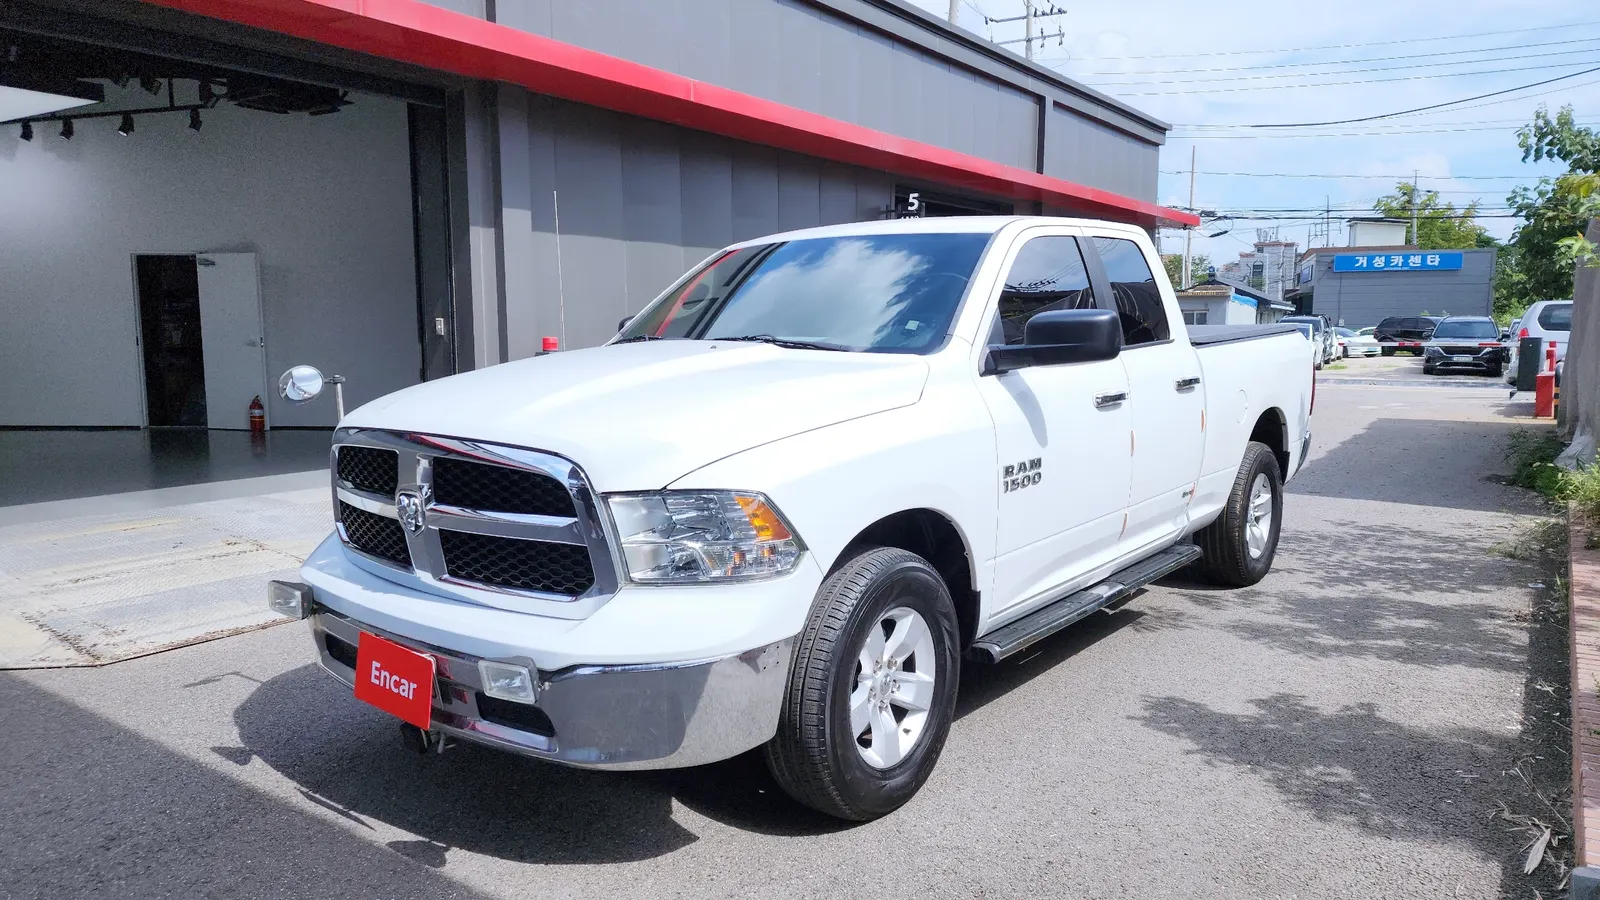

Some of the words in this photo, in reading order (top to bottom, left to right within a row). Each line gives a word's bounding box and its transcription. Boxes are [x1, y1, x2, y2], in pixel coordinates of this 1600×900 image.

[907, 193, 919, 211] 5
[1354, 254, 1440, 268] 거성카센타
[1003, 457, 1042, 479] RAM
[1003, 471, 1042, 494] 1500
[370, 660, 418, 700] Encar
